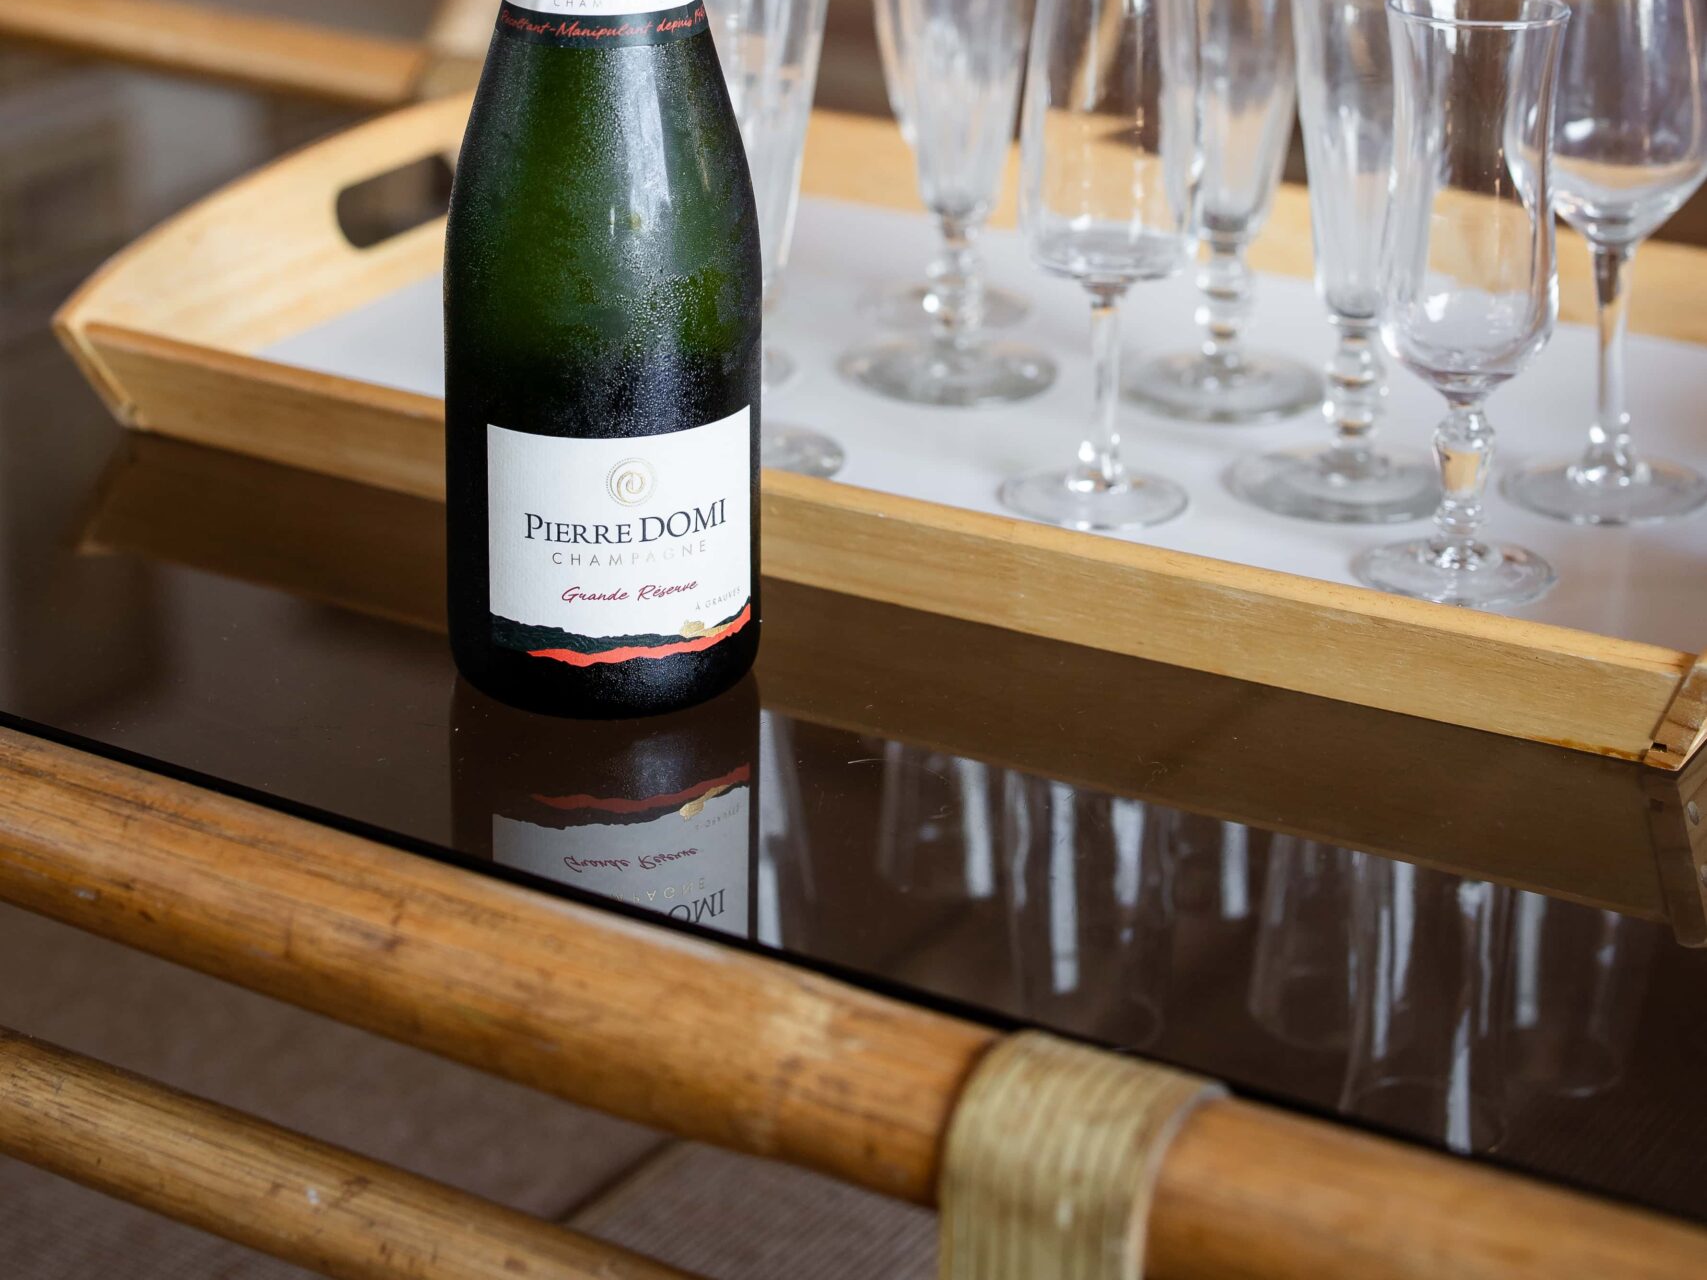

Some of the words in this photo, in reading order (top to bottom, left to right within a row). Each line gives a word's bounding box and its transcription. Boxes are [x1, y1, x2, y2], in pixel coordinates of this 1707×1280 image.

[656, 16, 693, 34] depuis
[524, 512, 632, 544] PIERRE
[638, 498, 728, 543] DOMI
[552, 539, 707, 567] CHAMPAGNE
[561, 586, 630, 603] Grande
[636, 580, 699, 601] Réserve
